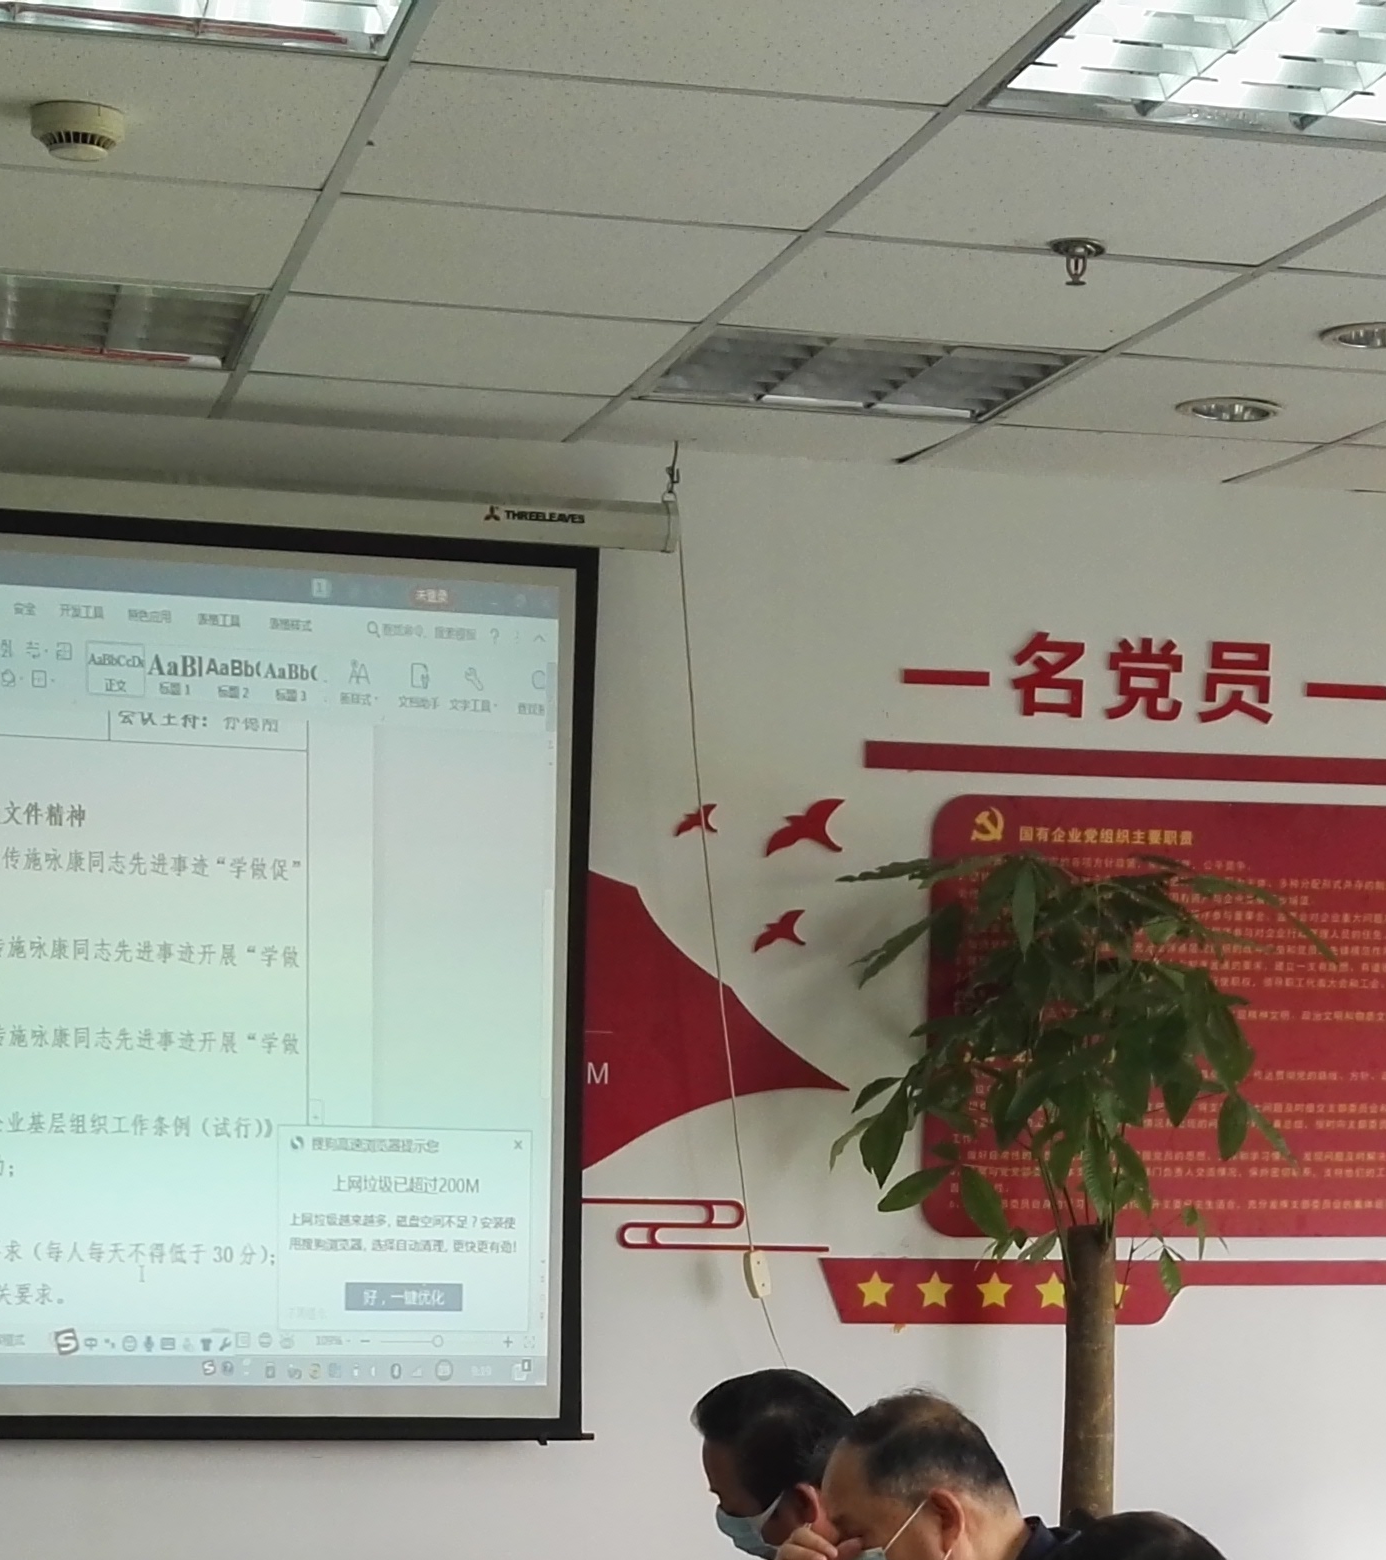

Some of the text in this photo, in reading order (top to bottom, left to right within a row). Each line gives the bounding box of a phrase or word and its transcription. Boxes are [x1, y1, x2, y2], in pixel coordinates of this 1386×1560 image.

[503, 509, 586, 524] THREELEAVES
[59, 604, 105, 621] 开发工具
[104, 677, 128, 693] 正文
[448, 696, 493, 713] 文字工具
[1018, 824, 1194, 847] 国有企业党组织主要职责
[331, 1174, 481, 1195] 上网垃圾已超过200M
[362, 1288, 446, 1306] 好，一键优化
